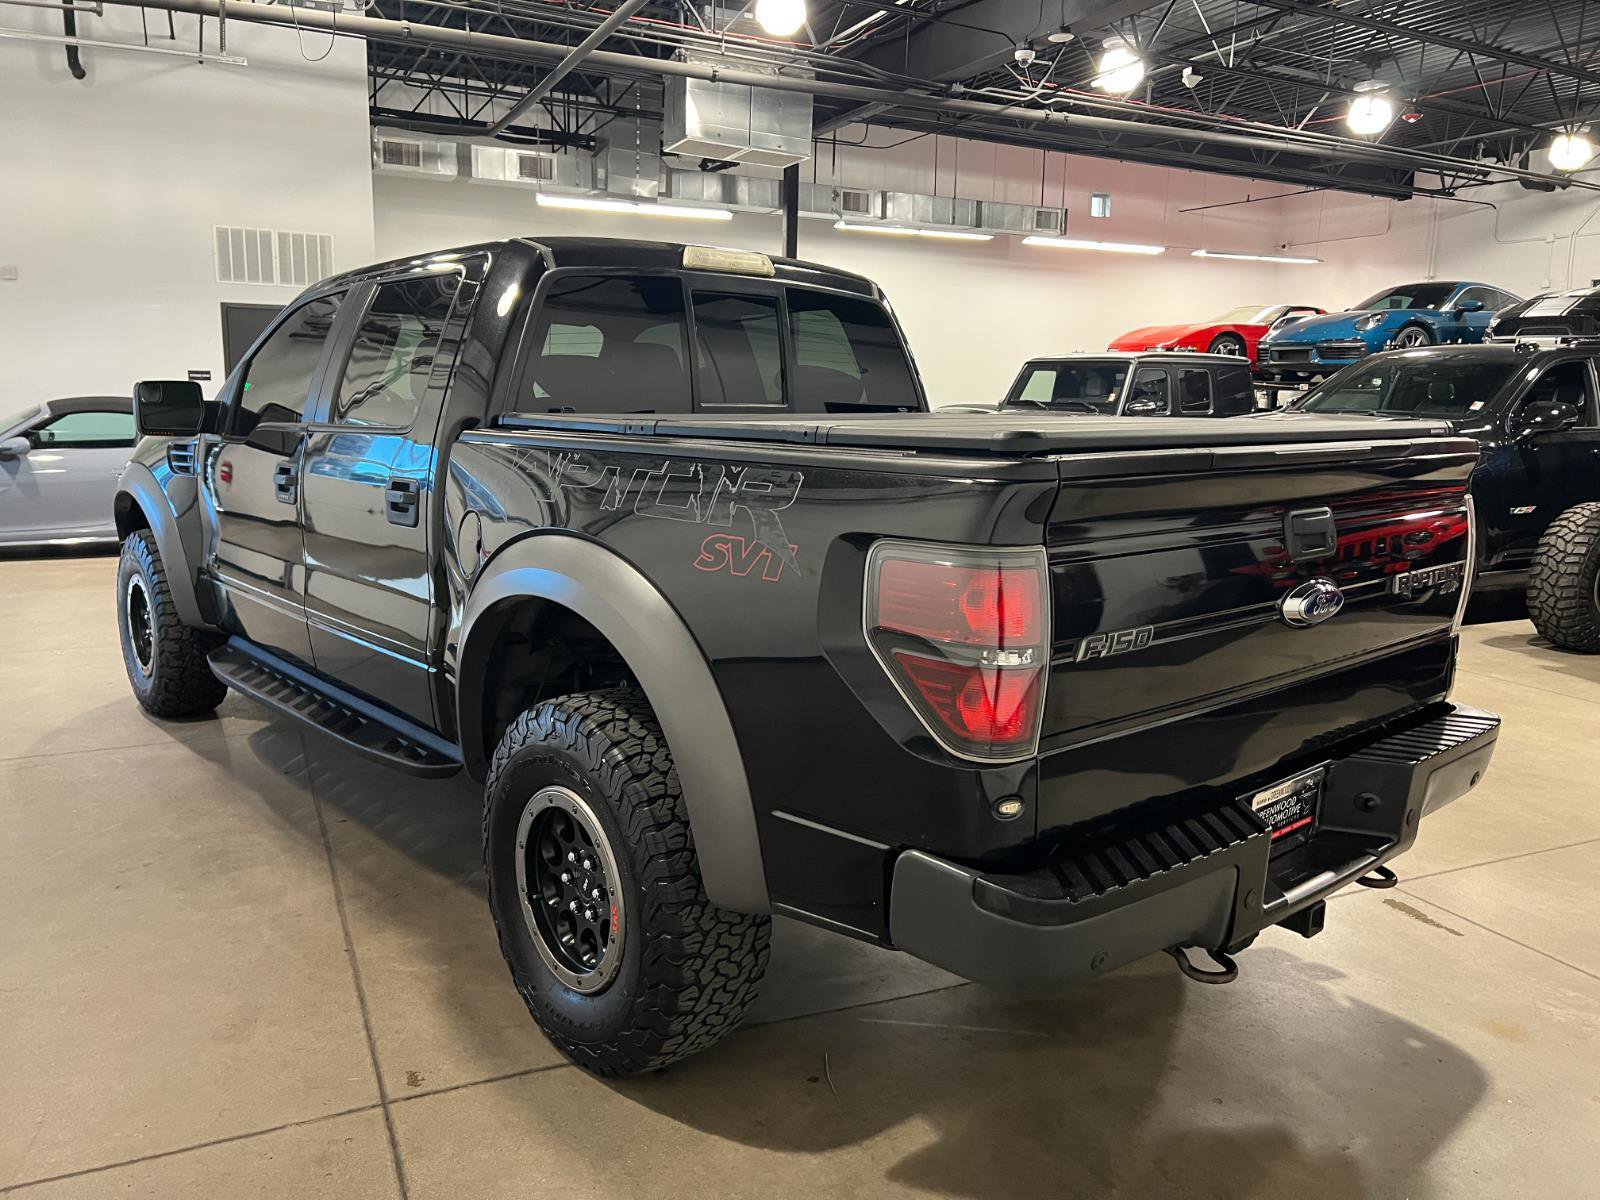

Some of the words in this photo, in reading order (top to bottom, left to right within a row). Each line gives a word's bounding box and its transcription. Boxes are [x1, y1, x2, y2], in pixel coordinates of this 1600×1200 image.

[484, 446, 804, 576] PTOR
[692, 533, 798, 582] SVT
[1313, 594, 1338, 615] Ford
[1264, 803, 1302, 826] UTOMOTIVE
